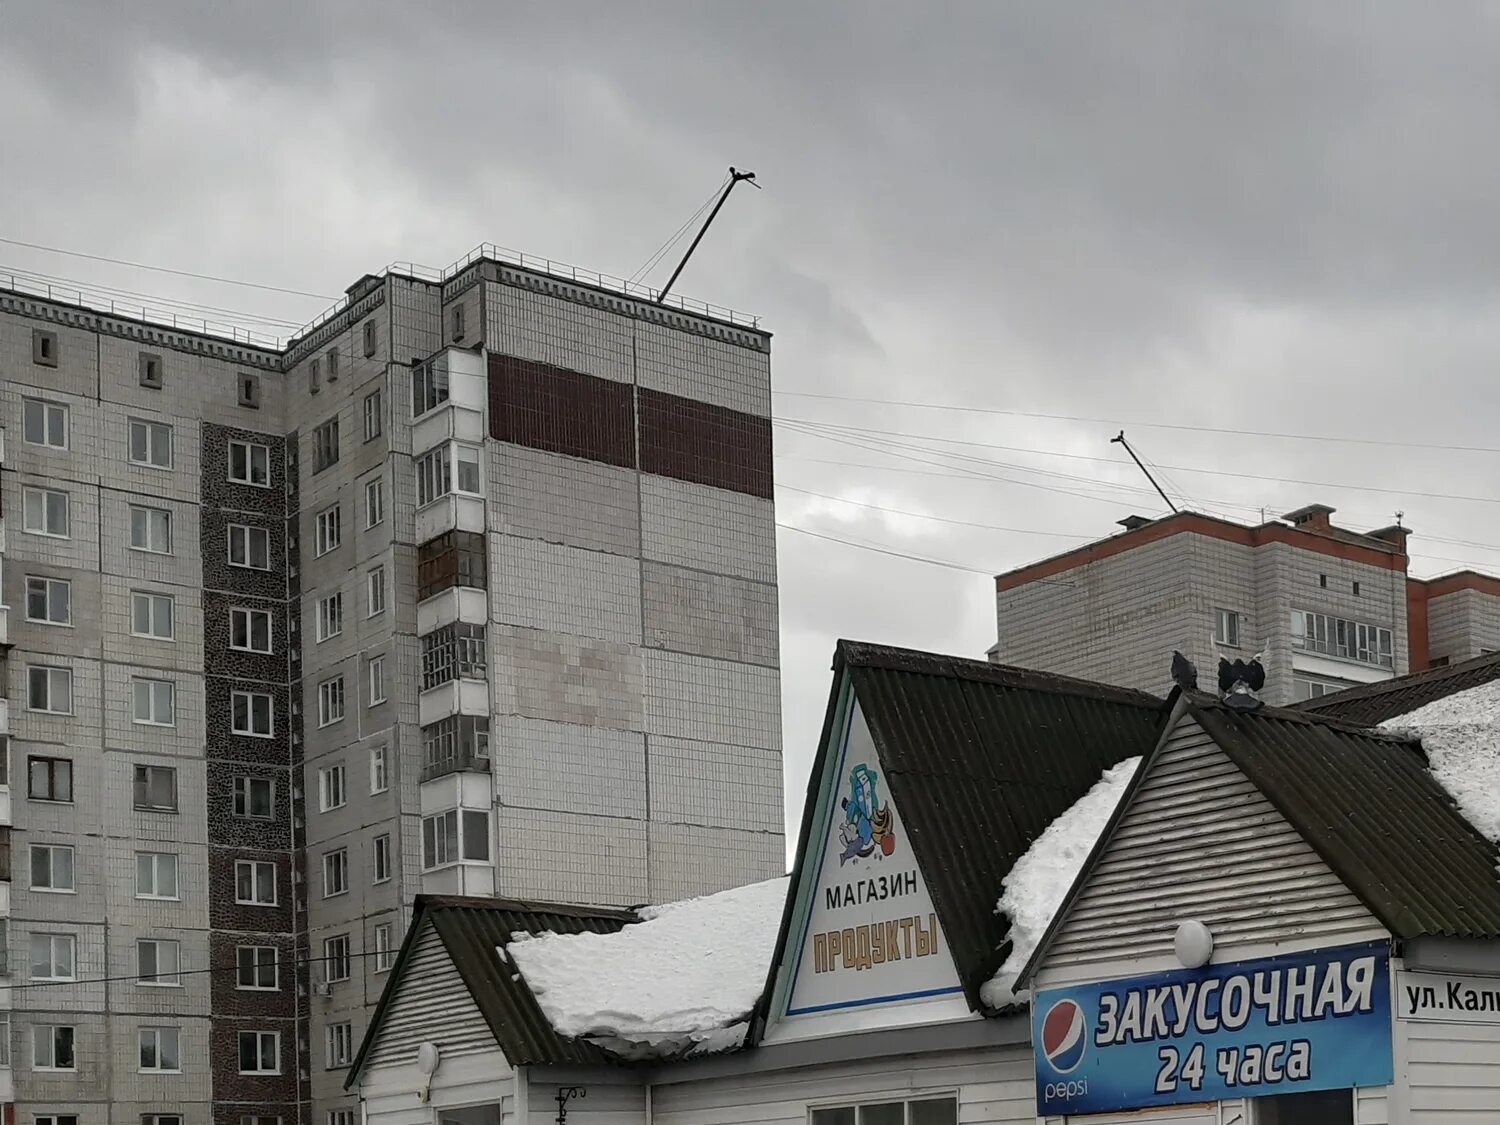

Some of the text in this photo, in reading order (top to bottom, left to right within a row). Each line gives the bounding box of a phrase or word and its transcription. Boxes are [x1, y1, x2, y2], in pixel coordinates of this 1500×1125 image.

[825, 870, 917, 910] МАГАЗИН
[813, 913, 938, 973] ПРОДУКТЫ
[1094, 955, 1376, 1046] ЗАКУСОЧНАЯ
[1044, 1075, 1088, 1104] pepsi
[1155, 1038, 1311, 1093] 24 часа
